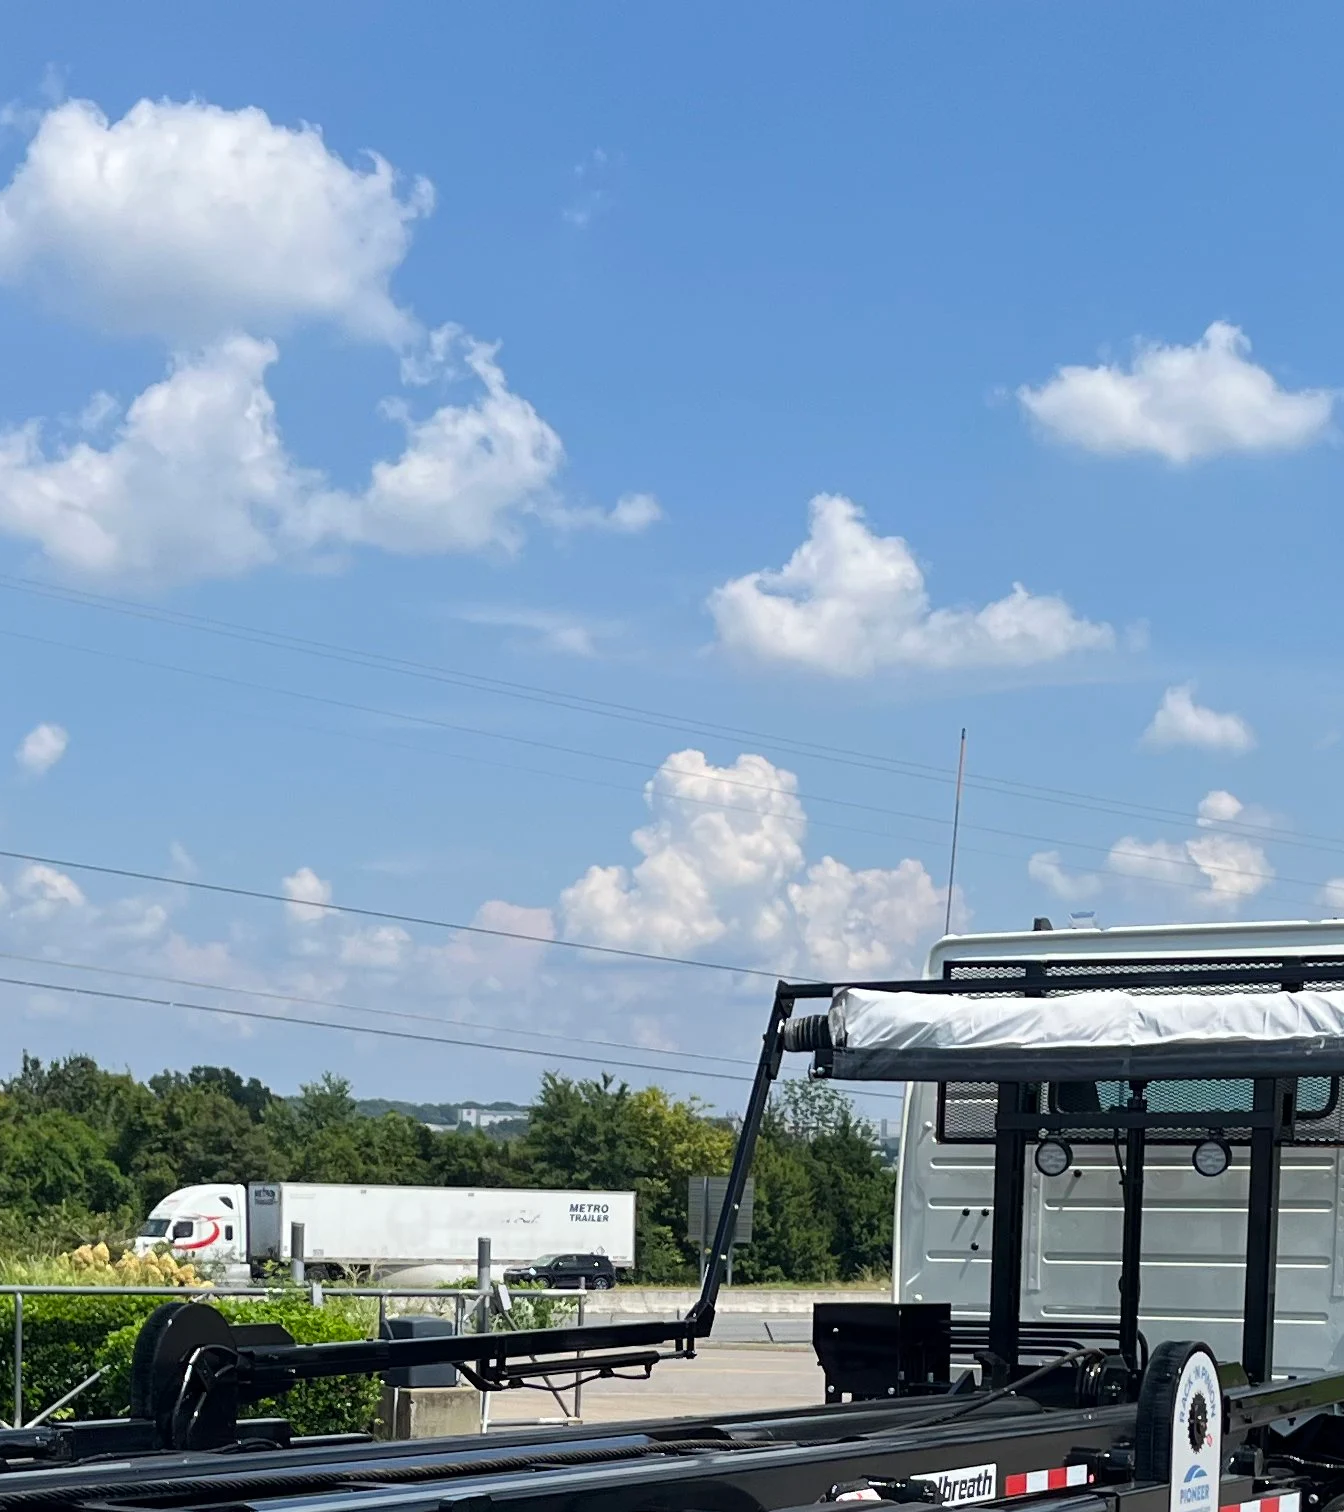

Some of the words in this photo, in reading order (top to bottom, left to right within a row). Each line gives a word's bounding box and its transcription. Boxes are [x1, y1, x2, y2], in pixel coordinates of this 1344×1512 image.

[569, 1203, 610, 1214] METRO
[569, 1214, 610, 1222] TRAILER
[1179, 1484, 1210, 1504] PIONEER
